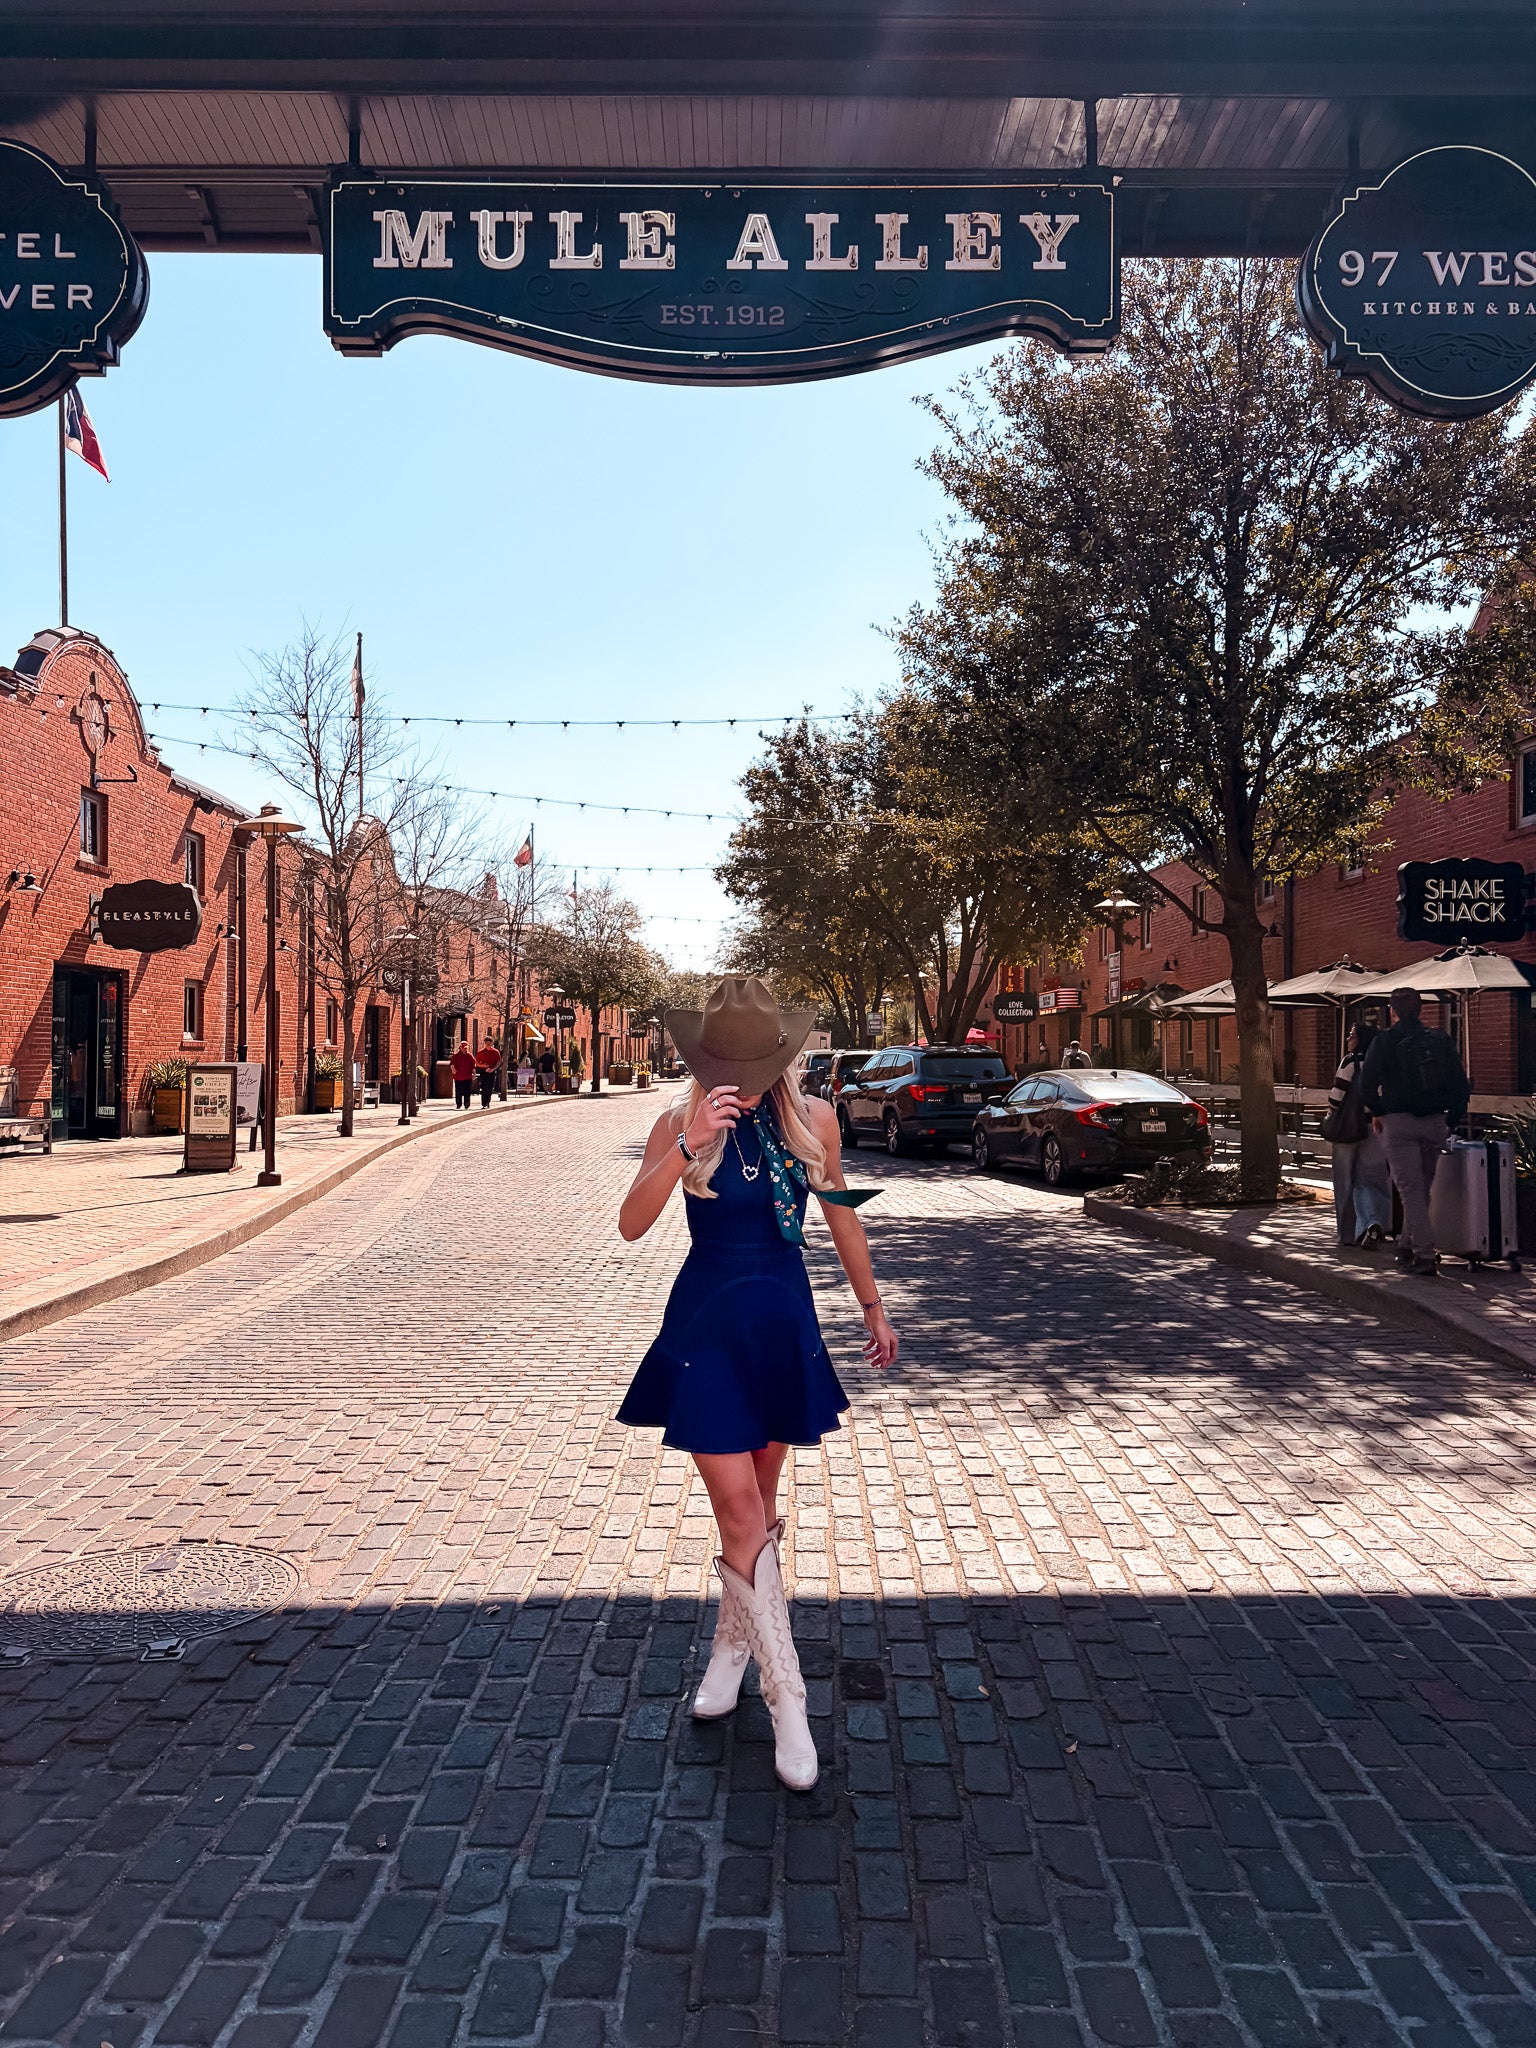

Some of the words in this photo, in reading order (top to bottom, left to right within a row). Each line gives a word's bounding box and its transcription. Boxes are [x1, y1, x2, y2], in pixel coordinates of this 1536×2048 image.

[373, 210, 676, 270] MULE
[726, 211, 1080, 270] ALLEY
[1338, 250, 1399, 287] 97
[1423, 251, 1536, 287] WES
[660, 305, 718, 325] EST.
[726, 306, 785, 326] 1912
[1363, 302, 1475, 315] KITCHEN
[1485, 302, 1499, 315] &
[1424, 879, 1505, 899] SHAKE
[1423, 902, 1506, 923] SHACK
[998, 1008, 1034, 1016] COLLECTION
